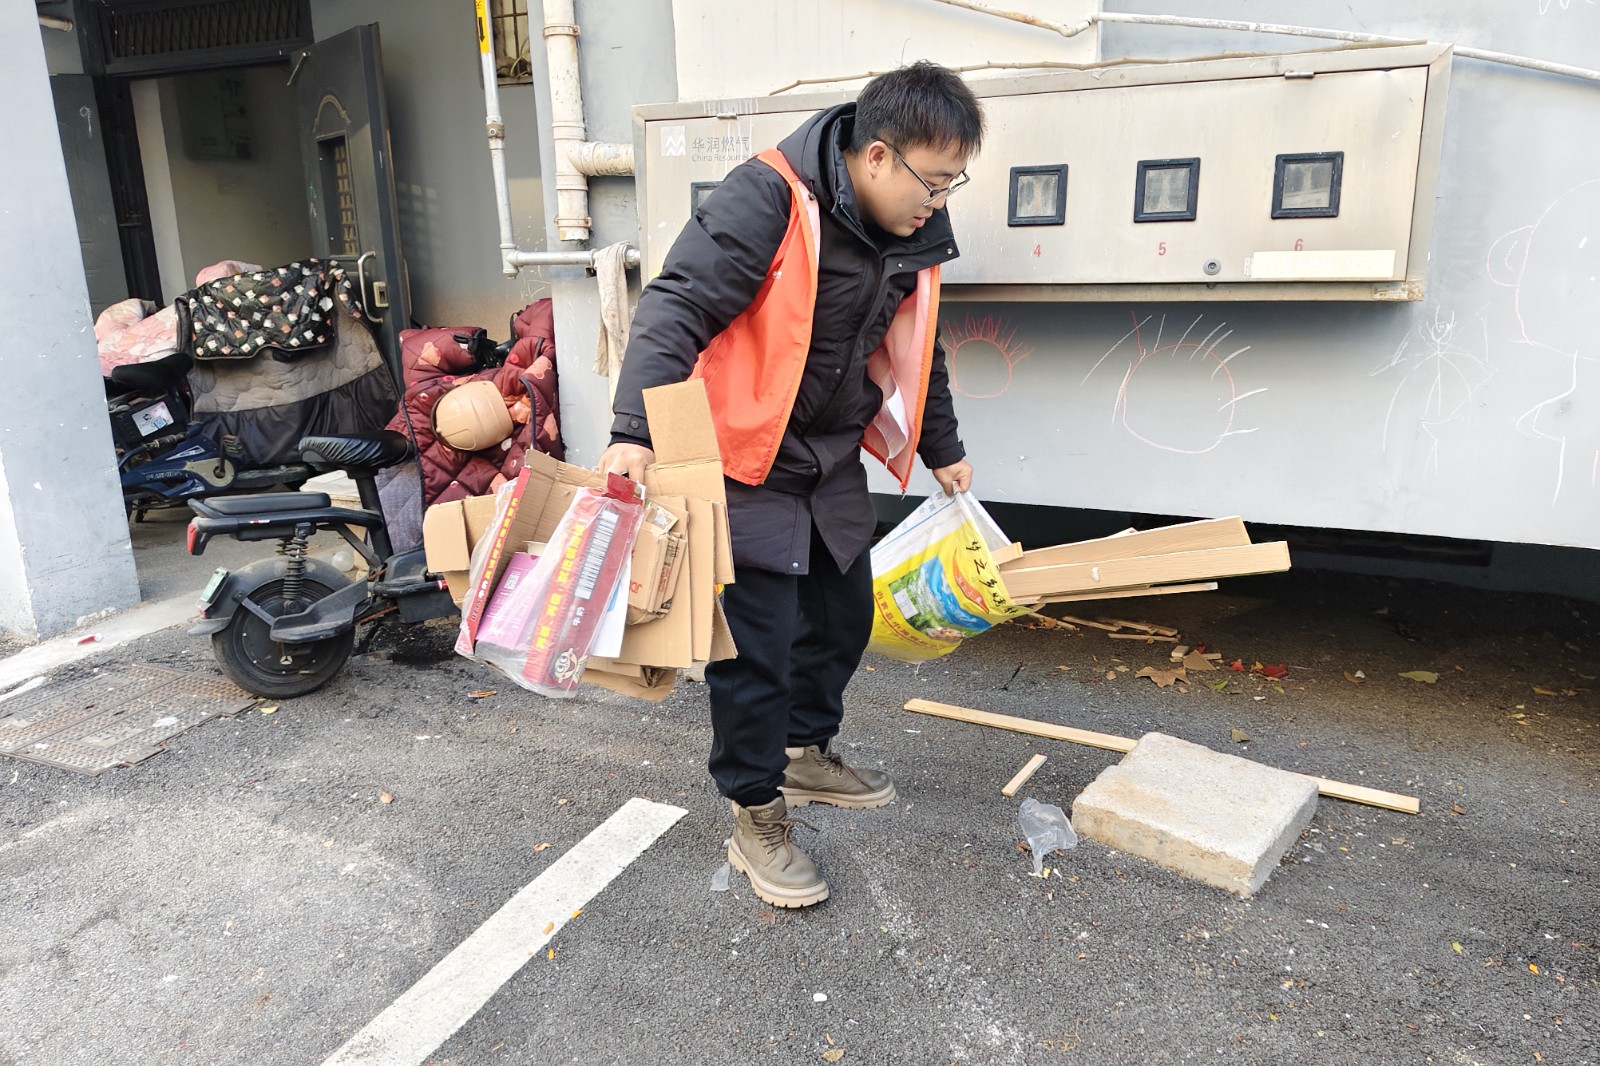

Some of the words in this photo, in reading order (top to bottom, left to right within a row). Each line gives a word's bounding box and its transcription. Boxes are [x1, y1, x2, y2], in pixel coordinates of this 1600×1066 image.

[692, 136, 750, 153] 华润燃气
[691, 154, 713, 163] China
[1033, 244, 1042, 258] 4
[1157, 242, 1167, 256] 5
[1294, 238, 1304, 252] 6
[572, 606, 586, 627] 牛奶
